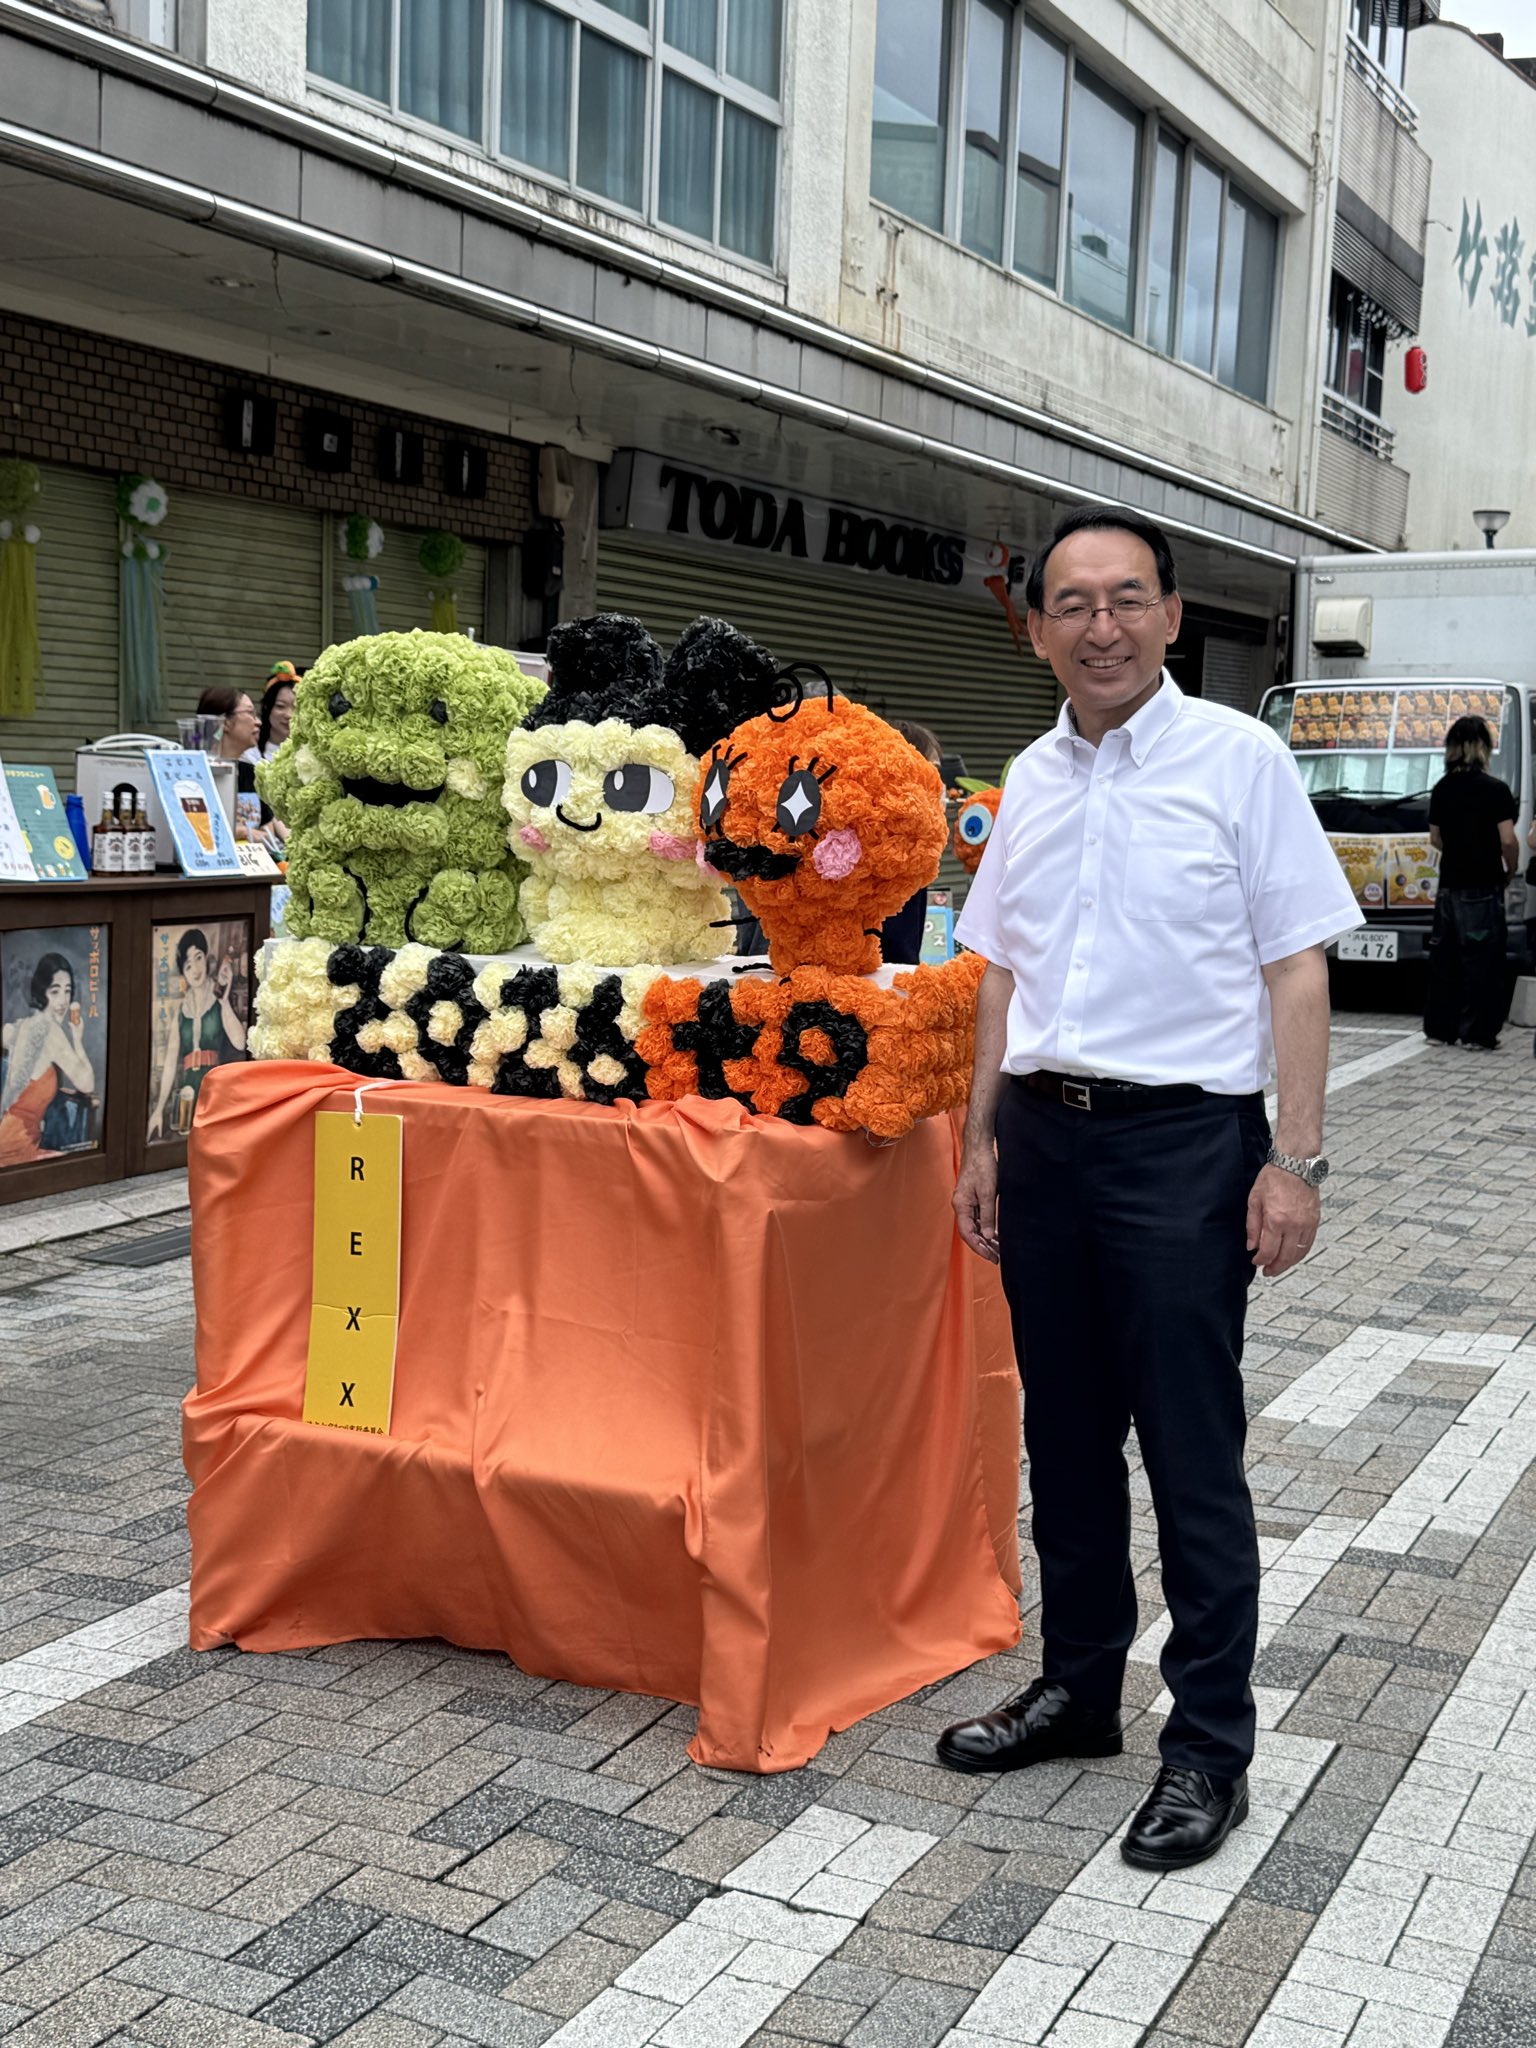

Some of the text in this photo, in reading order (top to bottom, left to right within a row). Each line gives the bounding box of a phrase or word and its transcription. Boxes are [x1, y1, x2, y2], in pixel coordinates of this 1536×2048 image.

[659, 464, 808, 559] TODA
[822, 507, 967, 586] BOOKS
[88, 926, 100, 1018] サッポロビール
[339, 1156, 365, 1408] REXX
